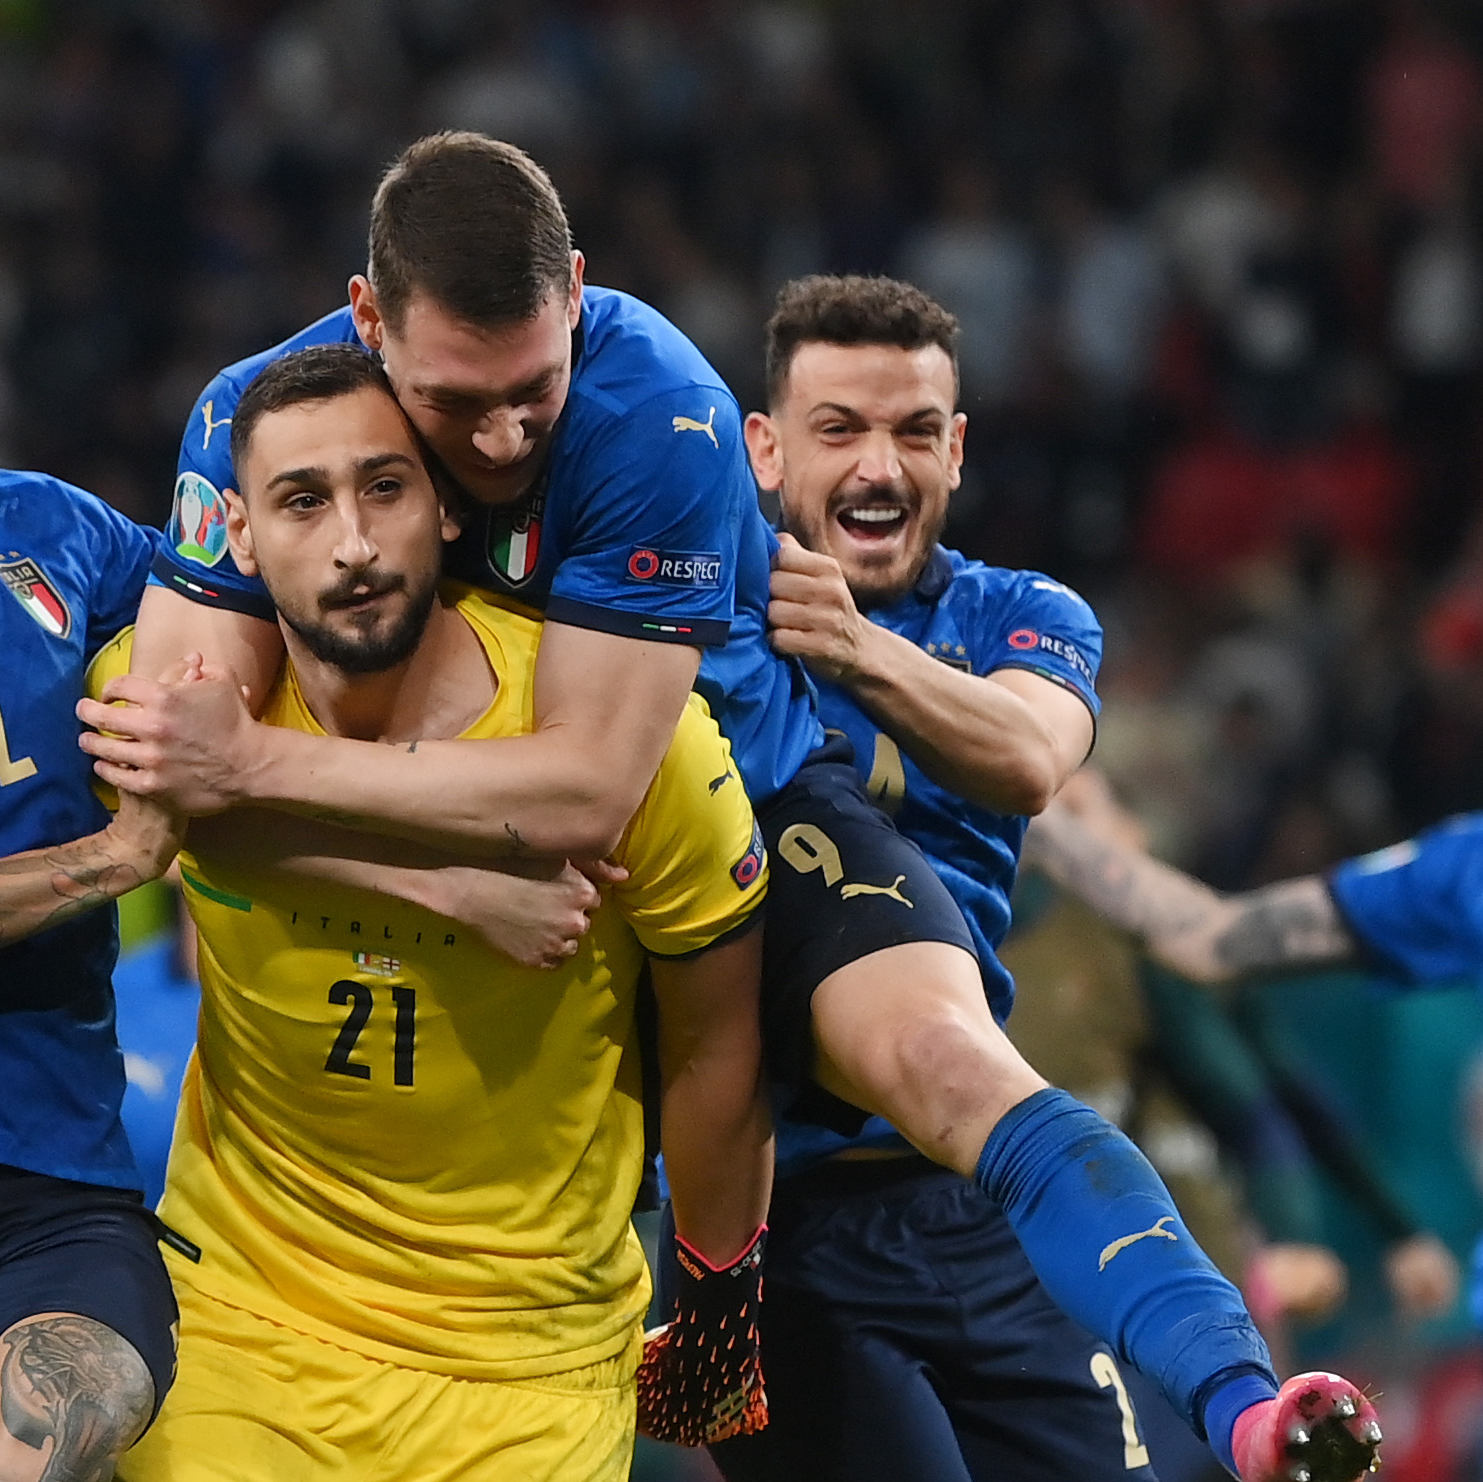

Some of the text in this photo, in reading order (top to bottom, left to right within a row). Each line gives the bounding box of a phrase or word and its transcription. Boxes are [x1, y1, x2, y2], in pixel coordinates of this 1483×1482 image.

[660, 559, 721, 580] RESPECT
[1040, 635, 1094, 685] RESPEC
[778, 823, 844, 888] 9
[291, 911, 456, 947] ITALIA
[324, 979, 416, 1087] 21
[1090, 1352, 1150, 1469] 2
